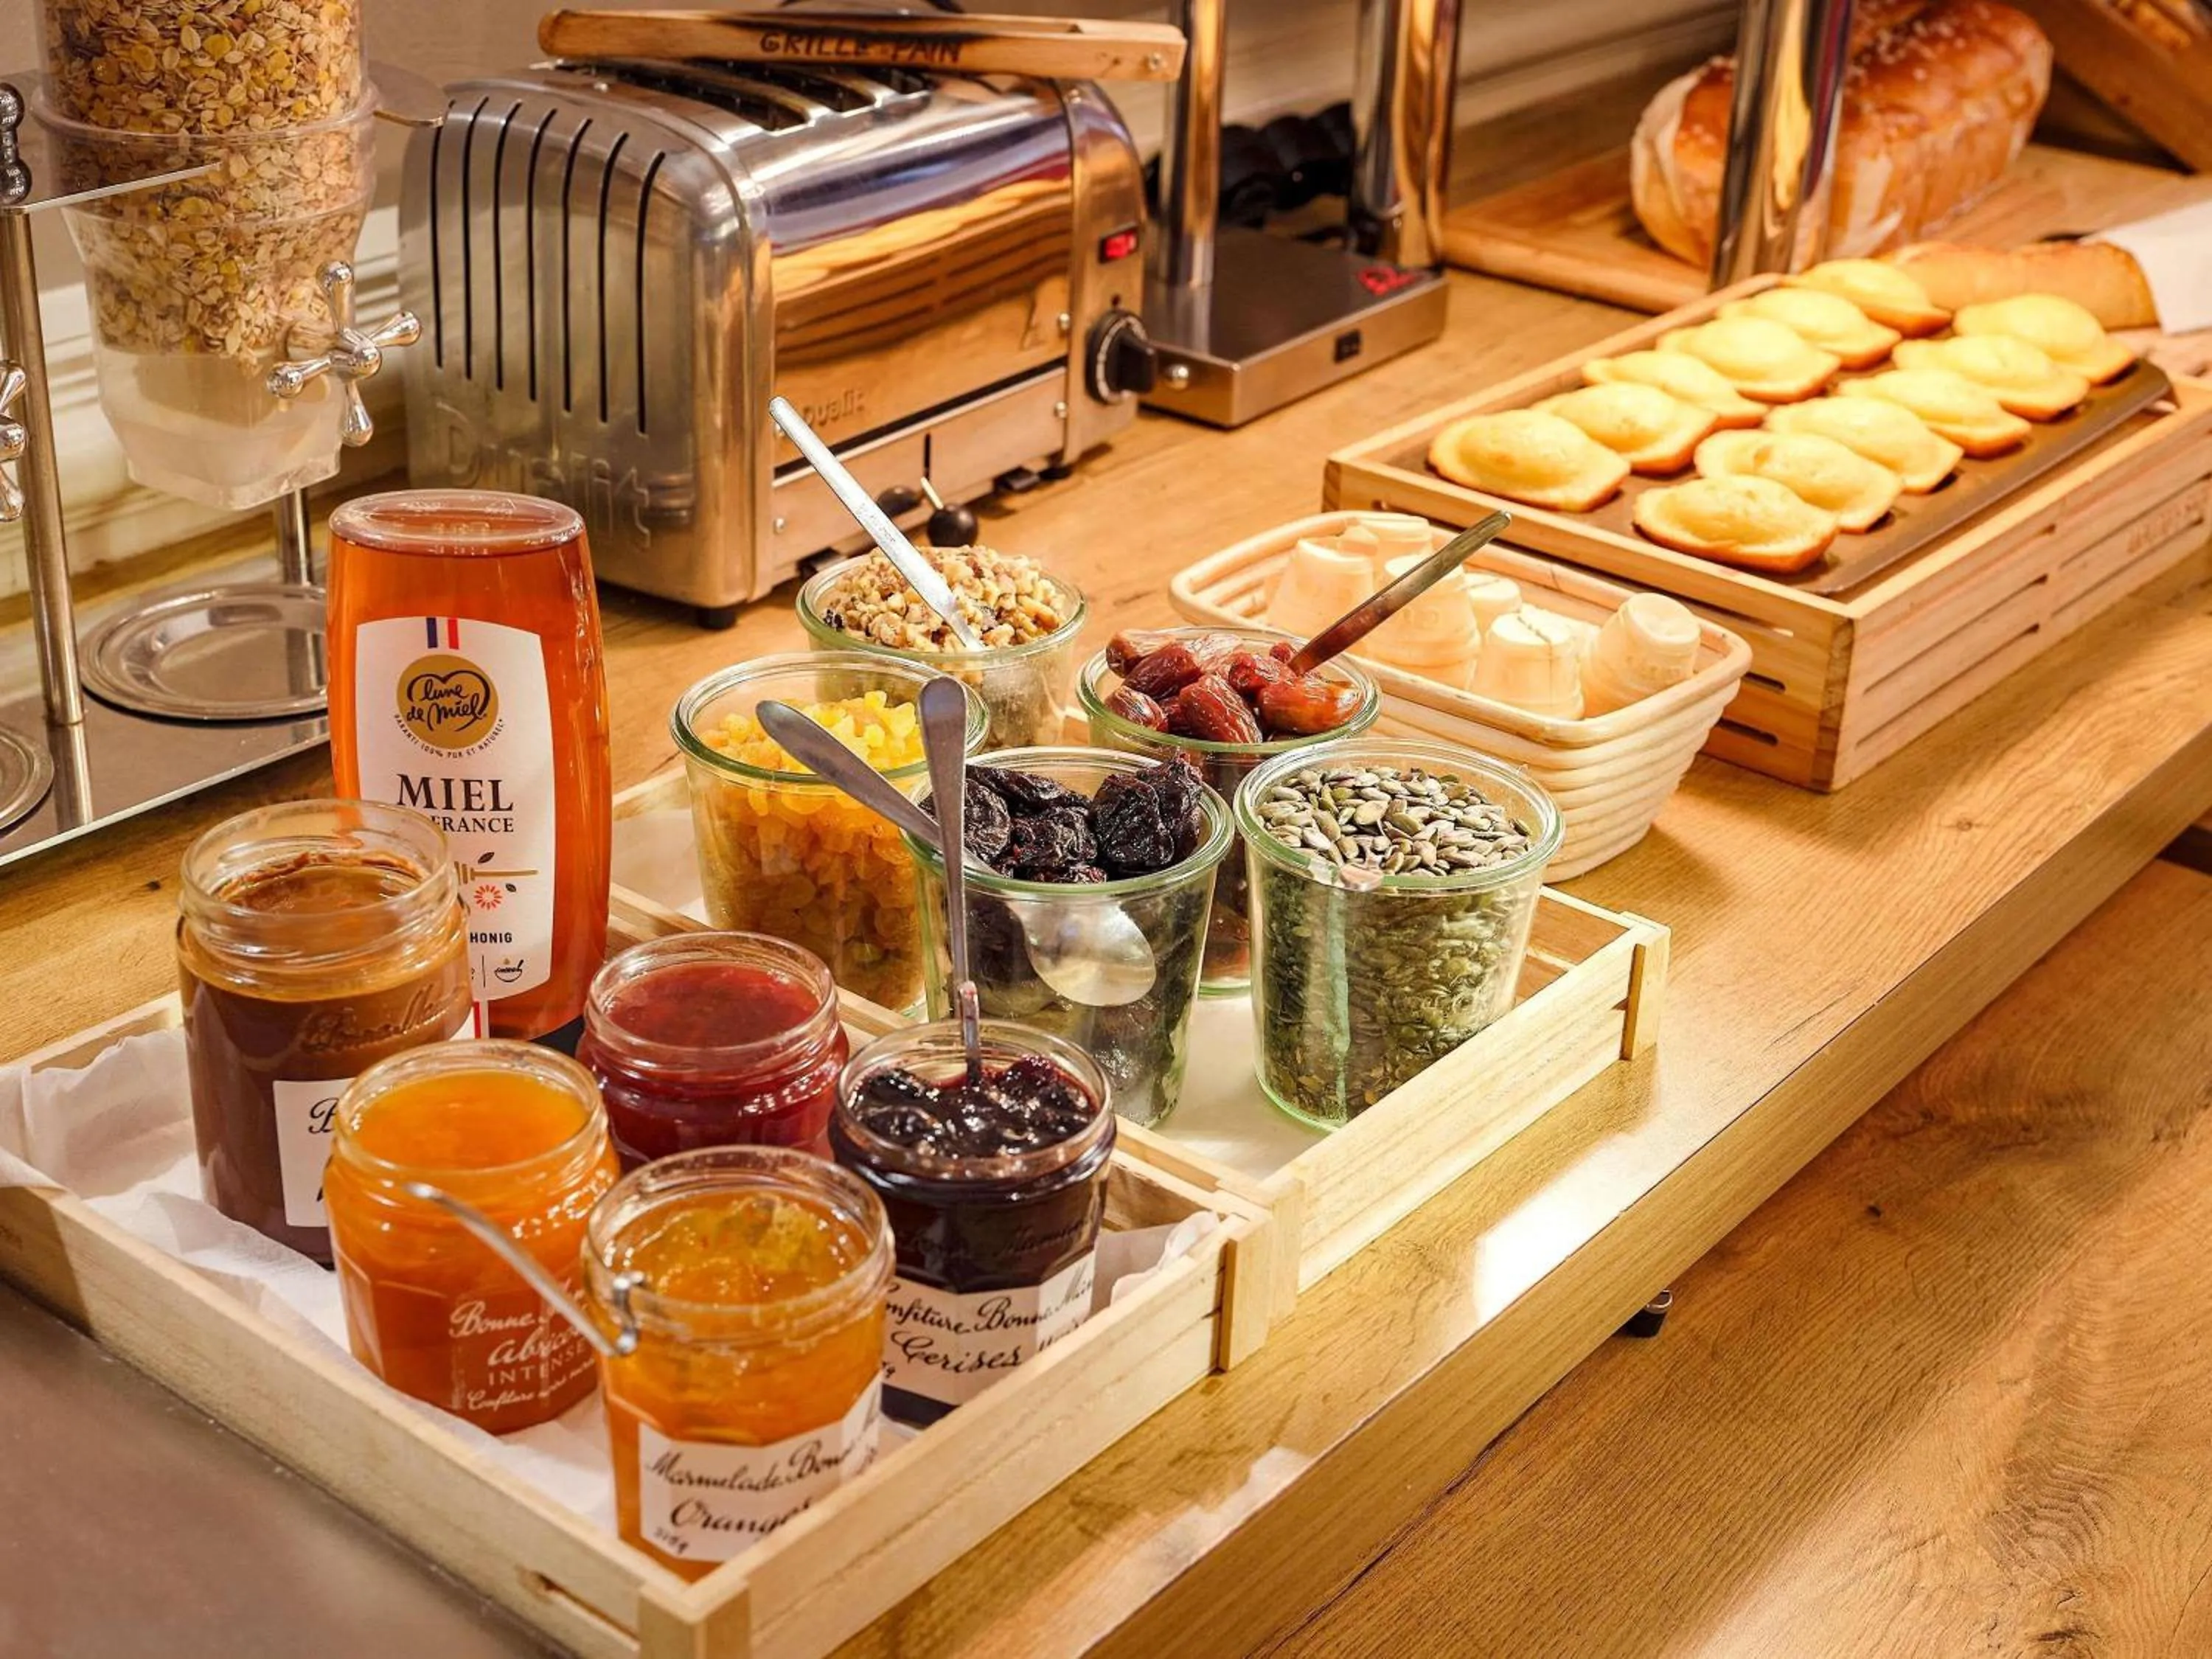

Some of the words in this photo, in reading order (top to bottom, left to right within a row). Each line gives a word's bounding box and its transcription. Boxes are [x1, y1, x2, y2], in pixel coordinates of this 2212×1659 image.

[406, 706, 426, 722] de
[396, 773, 514, 812] MIEL
[470, 931, 512, 943] HONIG
[448, 1300, 535, 1338] Bonne
[891, 1330, 1023, 1374] Cerises
